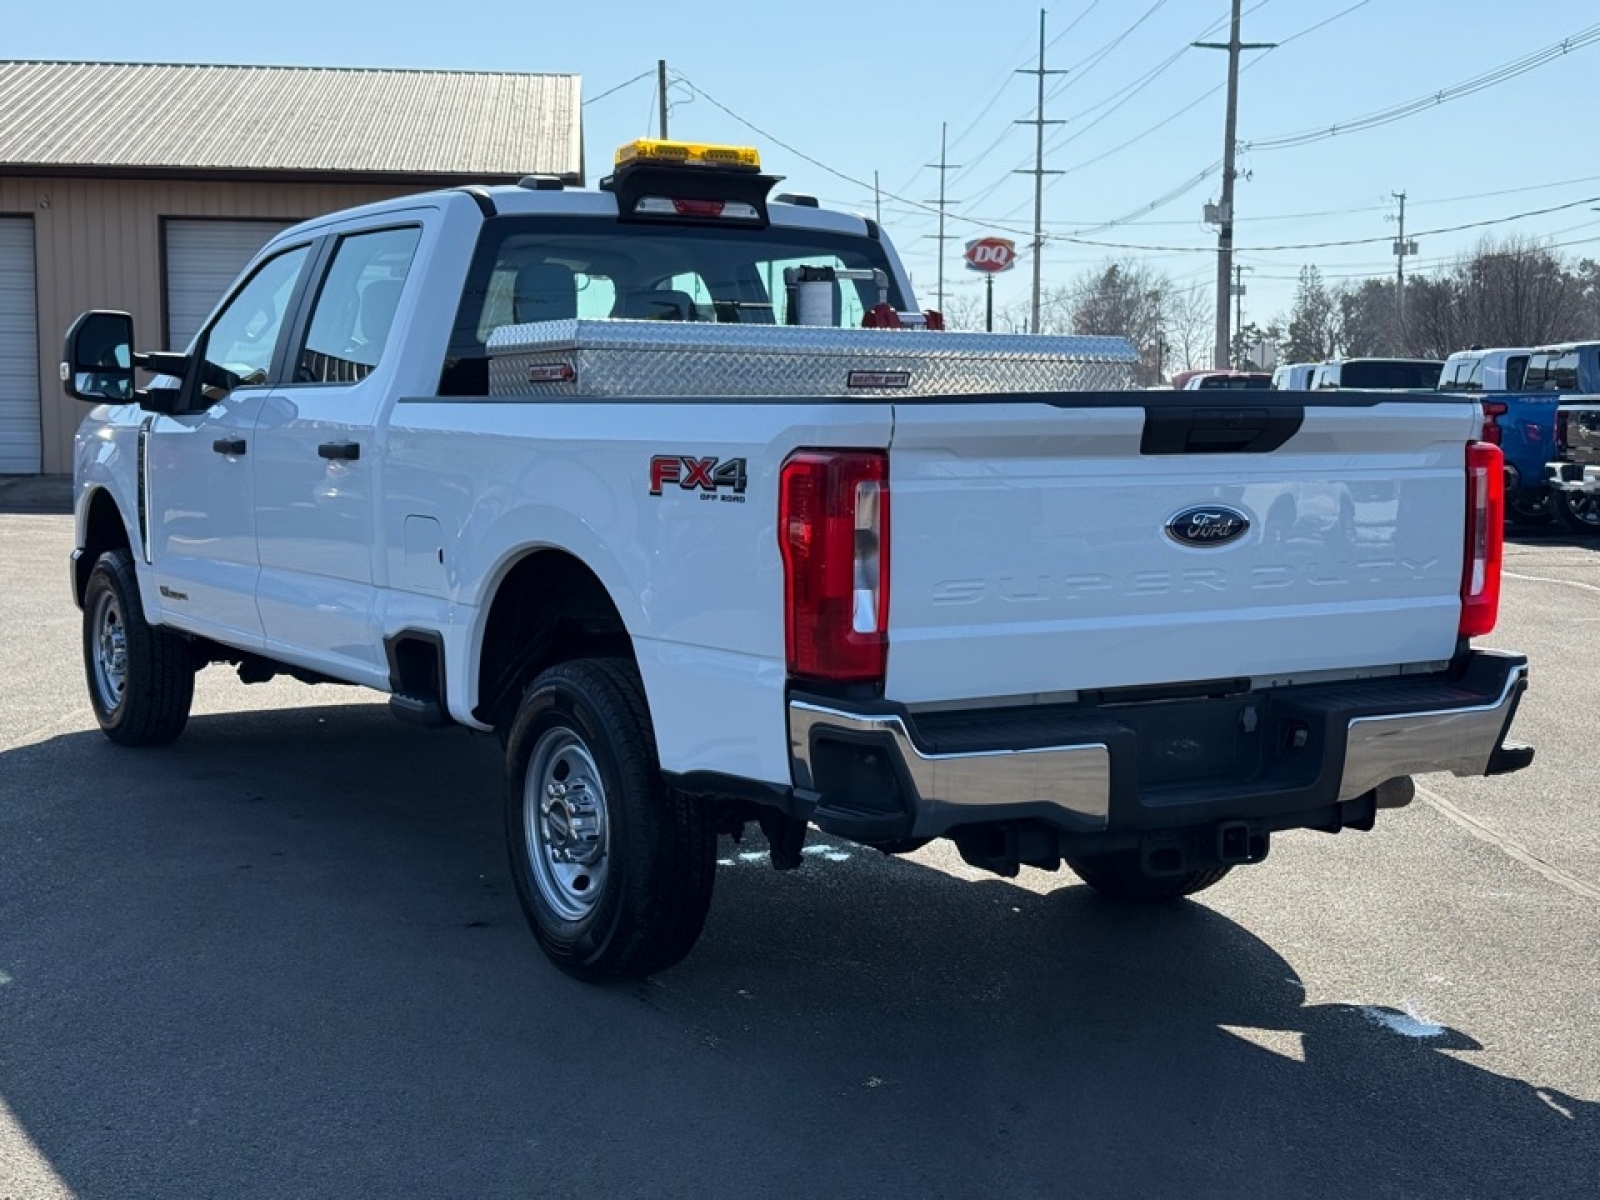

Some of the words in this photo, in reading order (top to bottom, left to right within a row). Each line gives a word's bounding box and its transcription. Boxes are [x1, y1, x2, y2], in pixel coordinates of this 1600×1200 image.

[974, 245, 1008, 265] DQ
[650, 455, 747, 496] FX4
[699, 493, 718, 501] OFF
[720, 494, 746, 503] ROAD
[1187, 512, 1233, 538] Ford
[932, 568, 1227, 606] SUPER
[1251, 554, 1439, 589] DUTY
